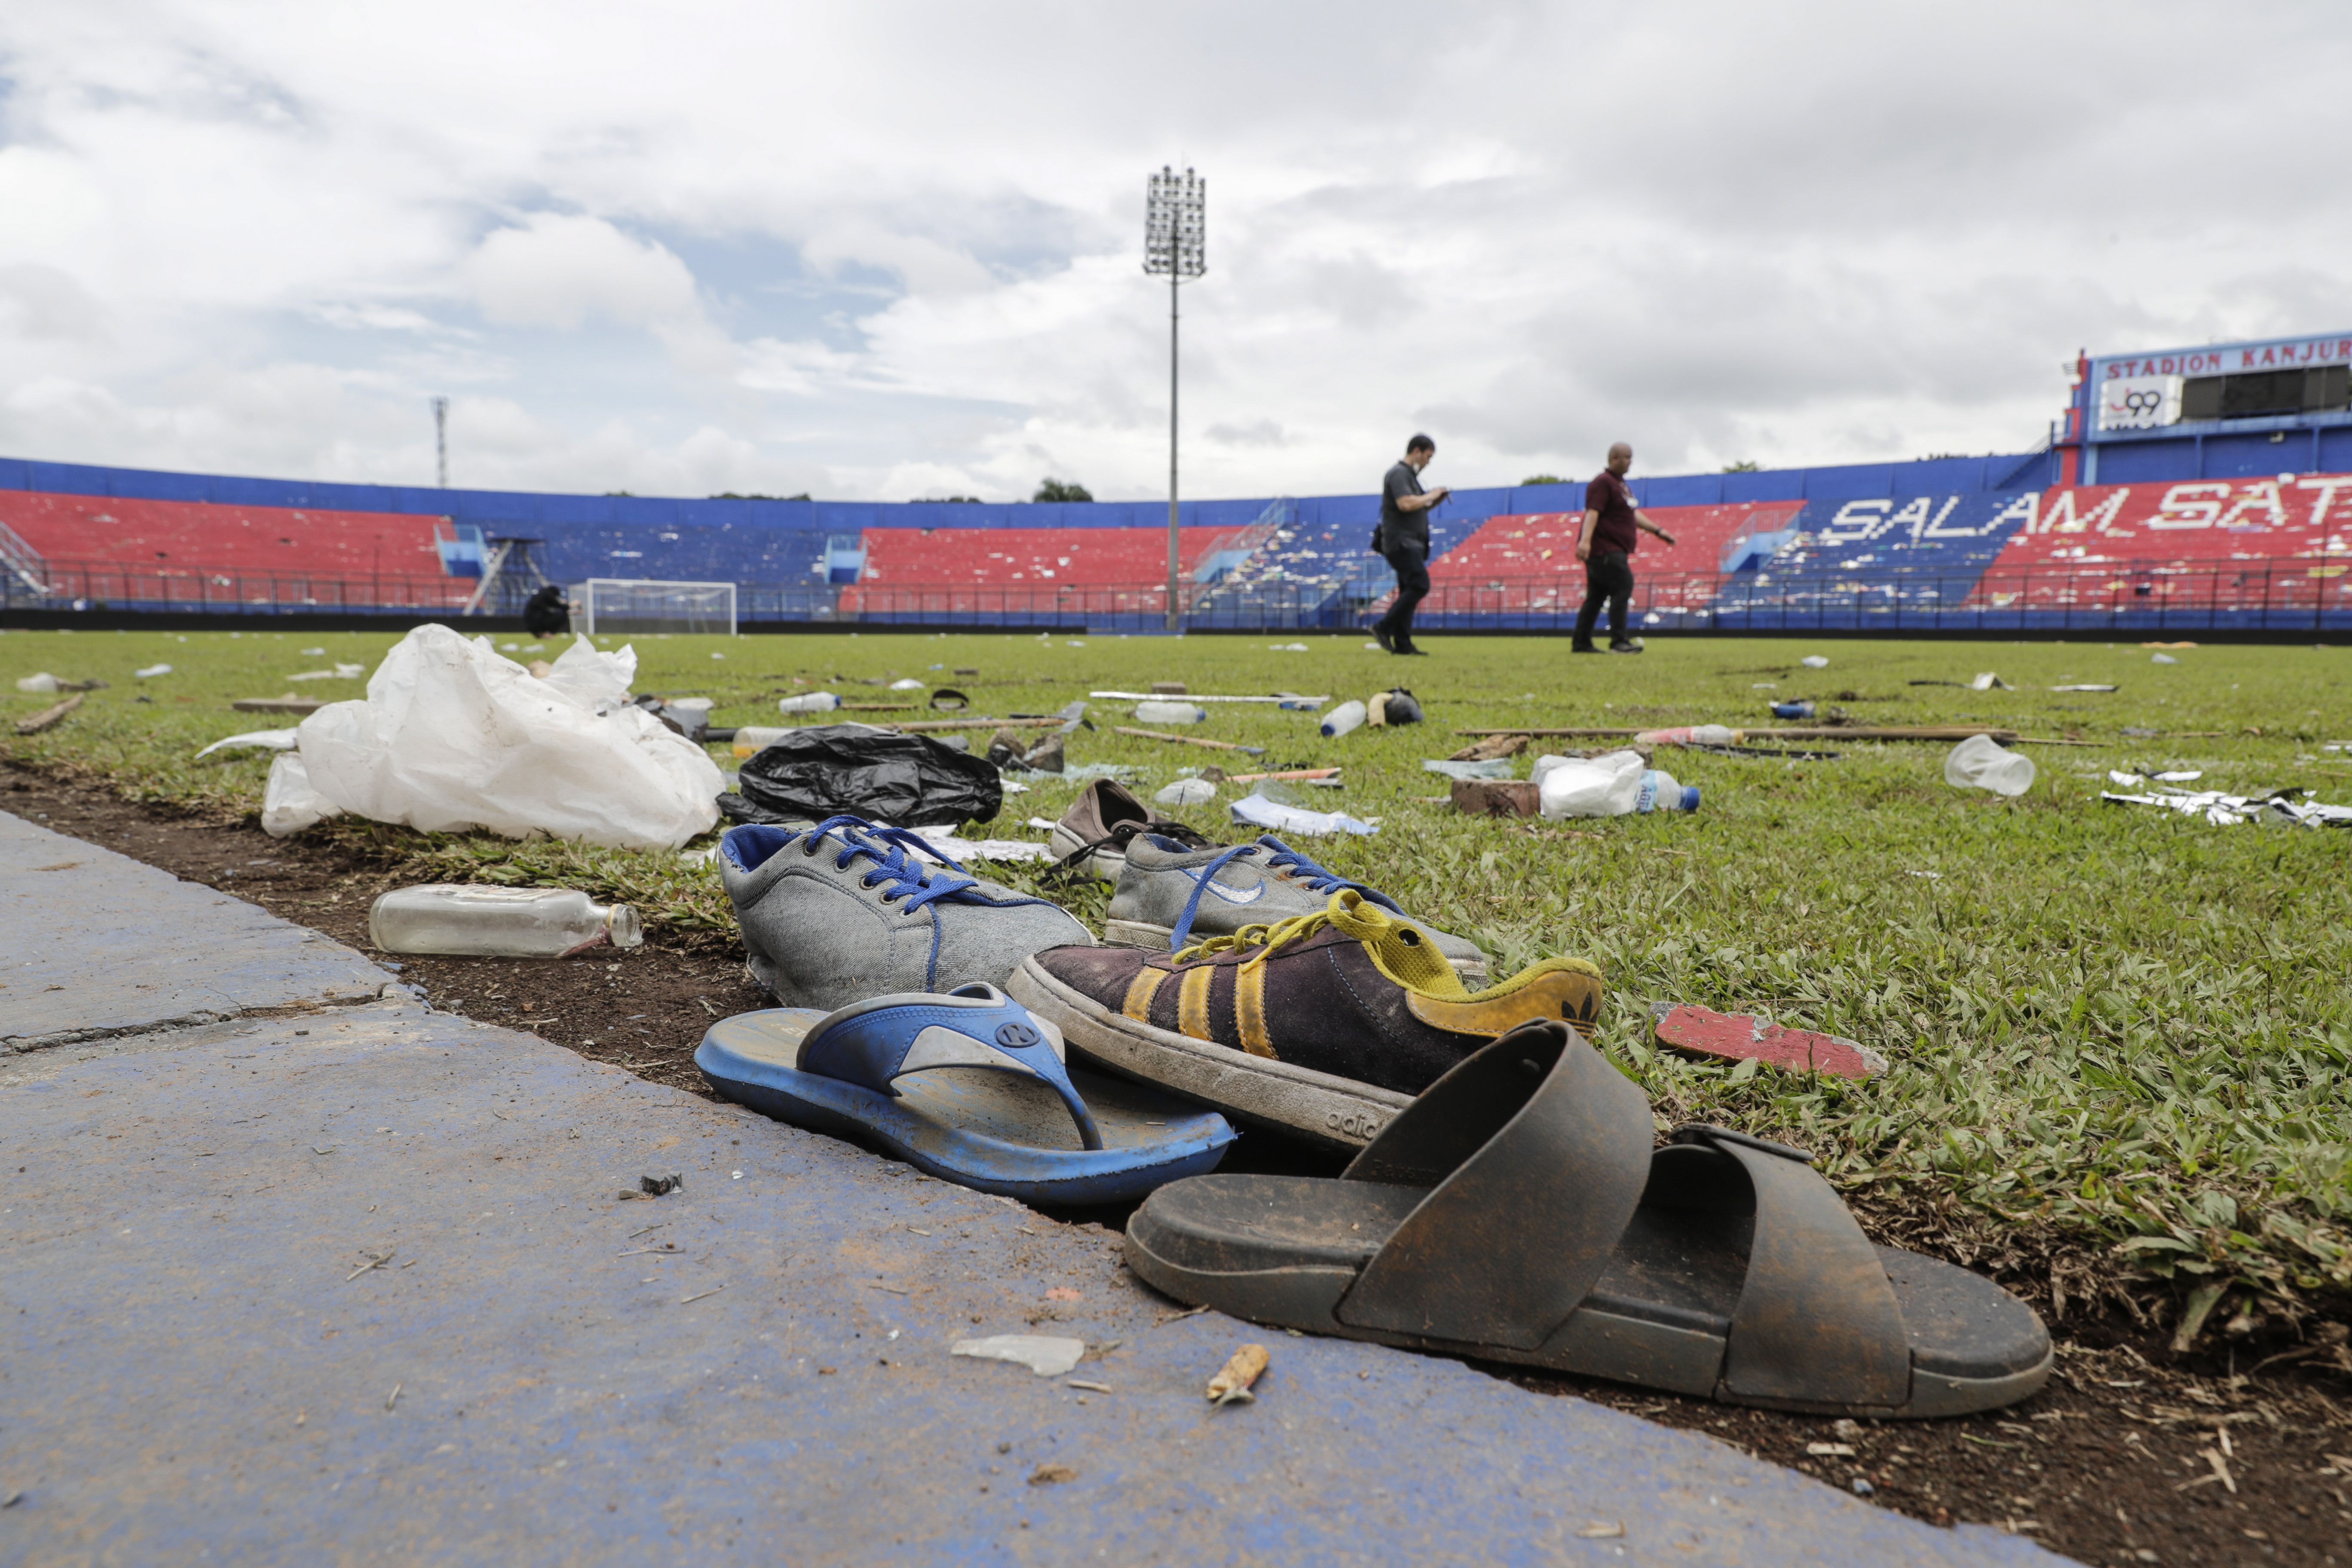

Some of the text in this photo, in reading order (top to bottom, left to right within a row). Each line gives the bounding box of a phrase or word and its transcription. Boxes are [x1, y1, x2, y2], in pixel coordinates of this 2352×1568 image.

[2107, 338, 2352, 379] STADION KANJUR
[1818, 487, 2130, 540] SALAM
